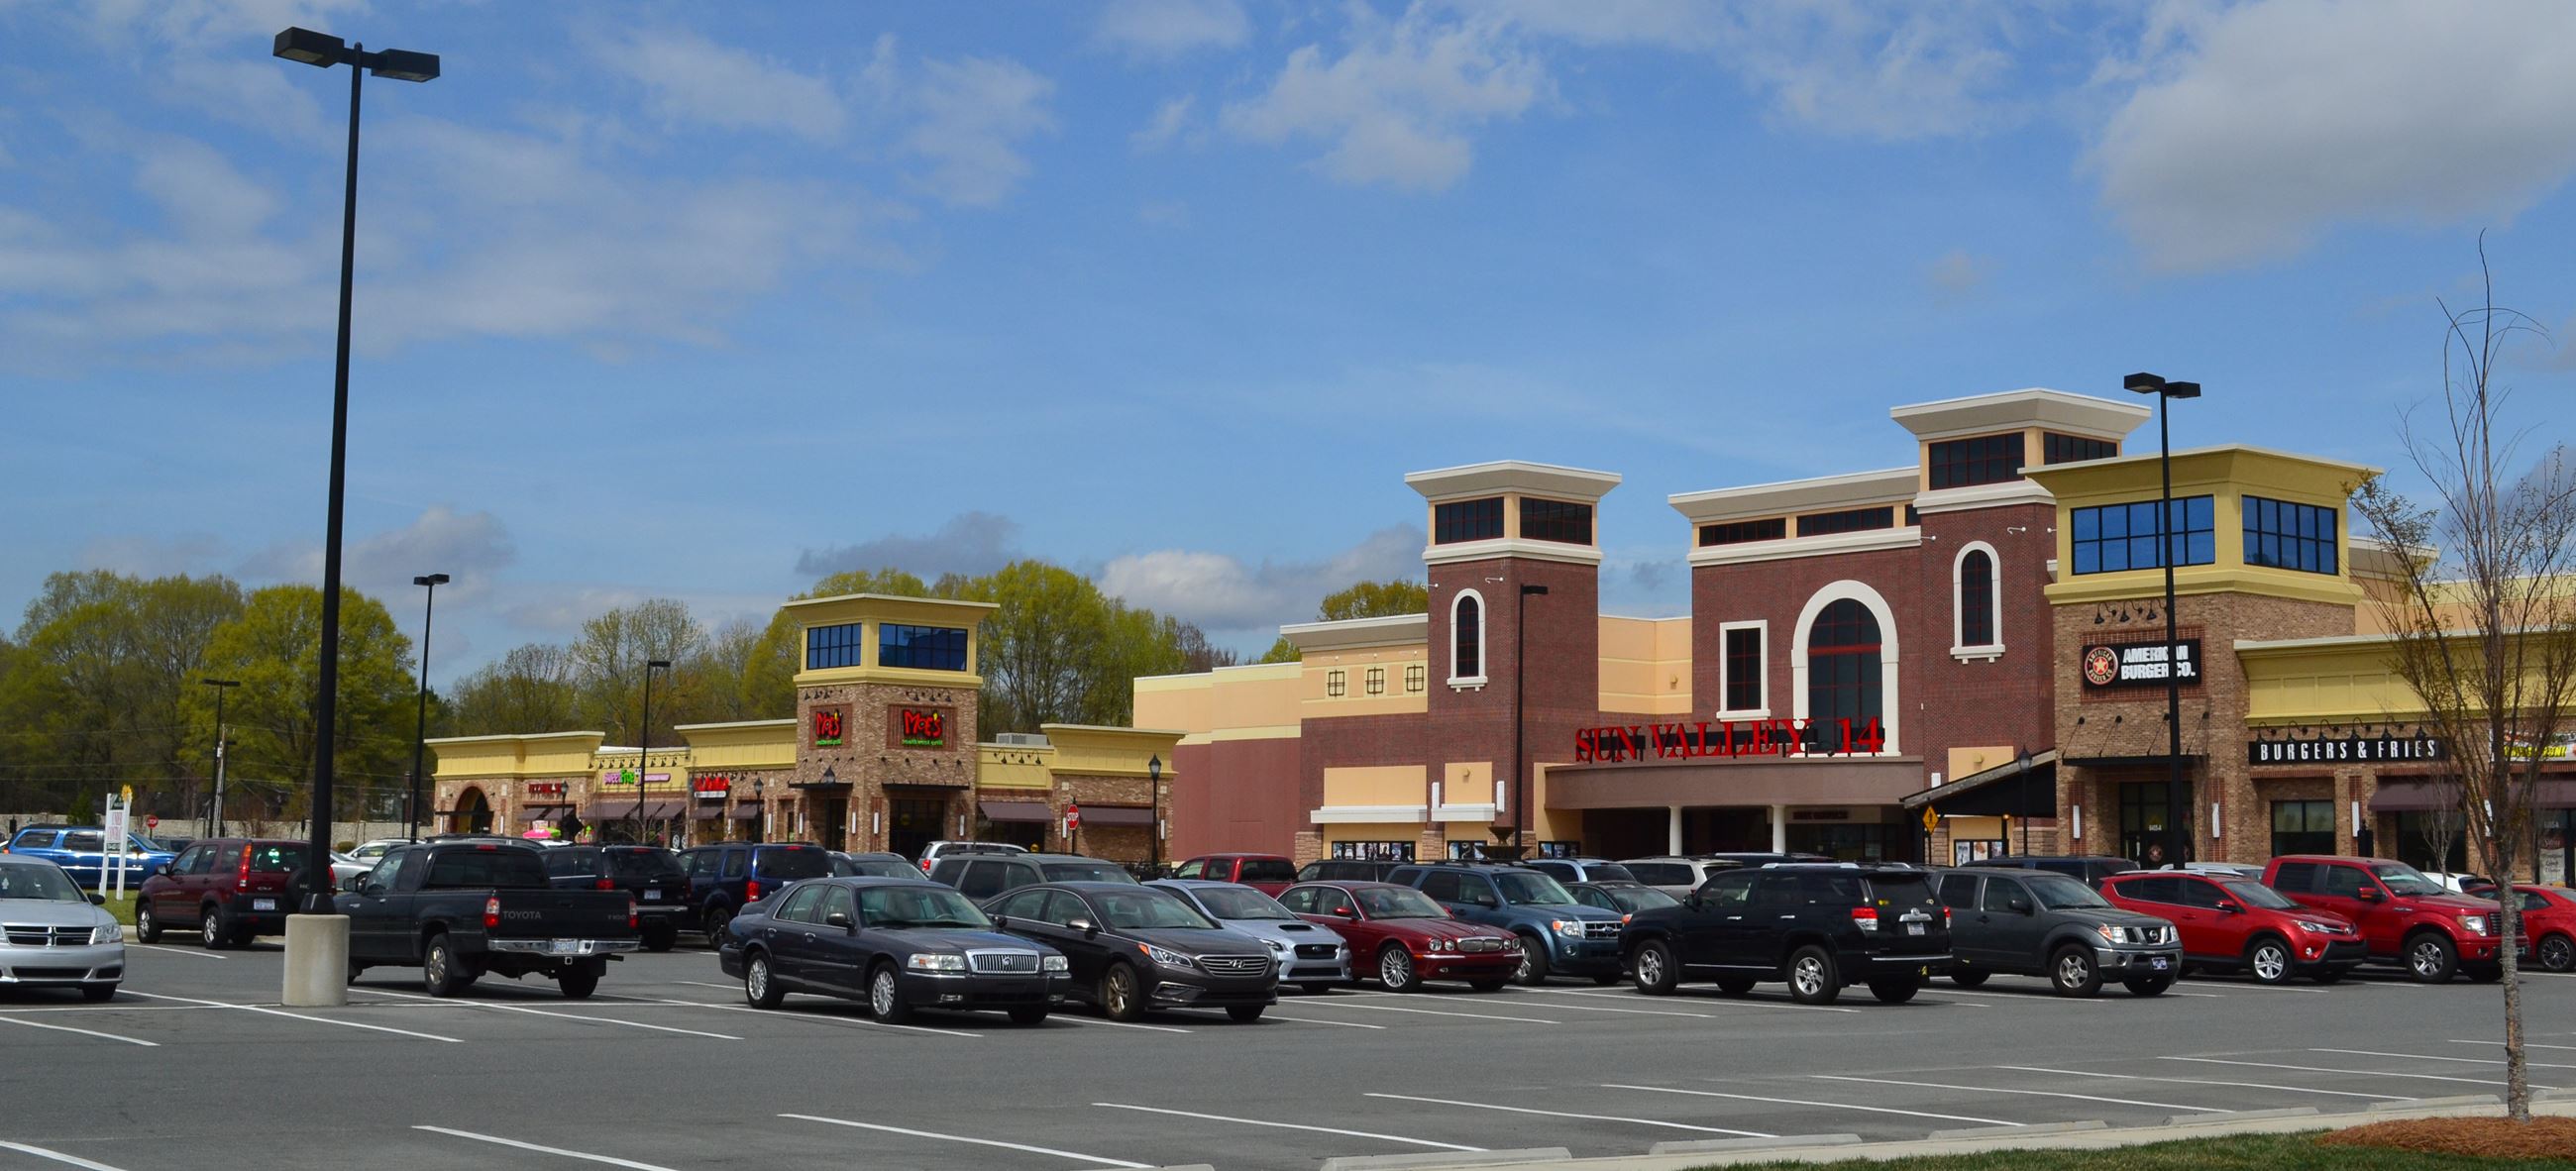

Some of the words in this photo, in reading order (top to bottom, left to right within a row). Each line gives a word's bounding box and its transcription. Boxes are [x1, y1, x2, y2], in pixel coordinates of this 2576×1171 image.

[2122, 645, 2189, 663] AMERICN
[2121, 663, 2169, 680] BURGER
[1575, 725, 1643, 762] SUN
[1650, 718, 1814, 758] VALLEY
[1837, 716, 1884, 755] 14
[2260, 742, 2347, 761] BURGERS
[2357, 740, 2367, 759] &
[2377, 740, 2434, 759] FRIES
[1067, 811, 1079, 822] STOP
[502, 910, 542, 920] TOYOTA
